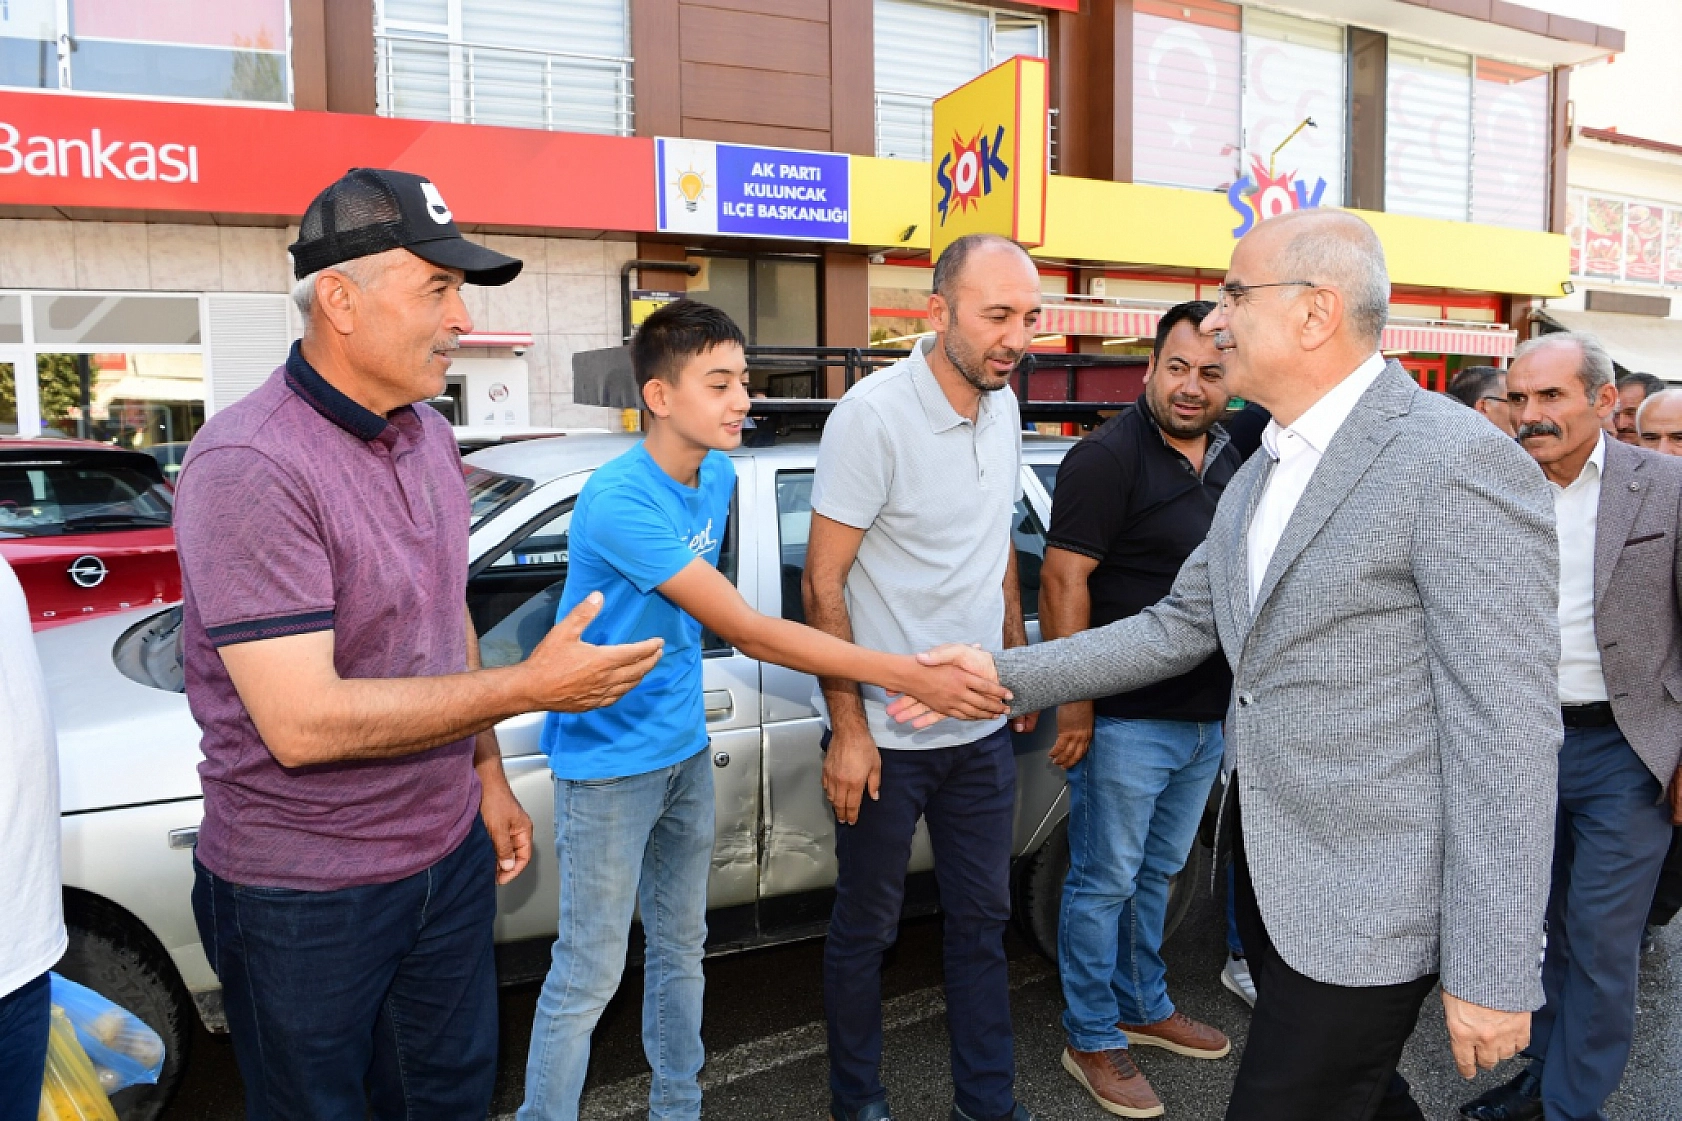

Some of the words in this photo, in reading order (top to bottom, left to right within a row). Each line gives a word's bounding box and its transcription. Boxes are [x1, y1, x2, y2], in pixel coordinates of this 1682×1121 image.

[0, 121, 199, 183] Bankası
[751, 162, 775, 177] AK
[744, 183, 827, 201] KULUNCAK
[937, 124, 1009, 227] ŞOK
